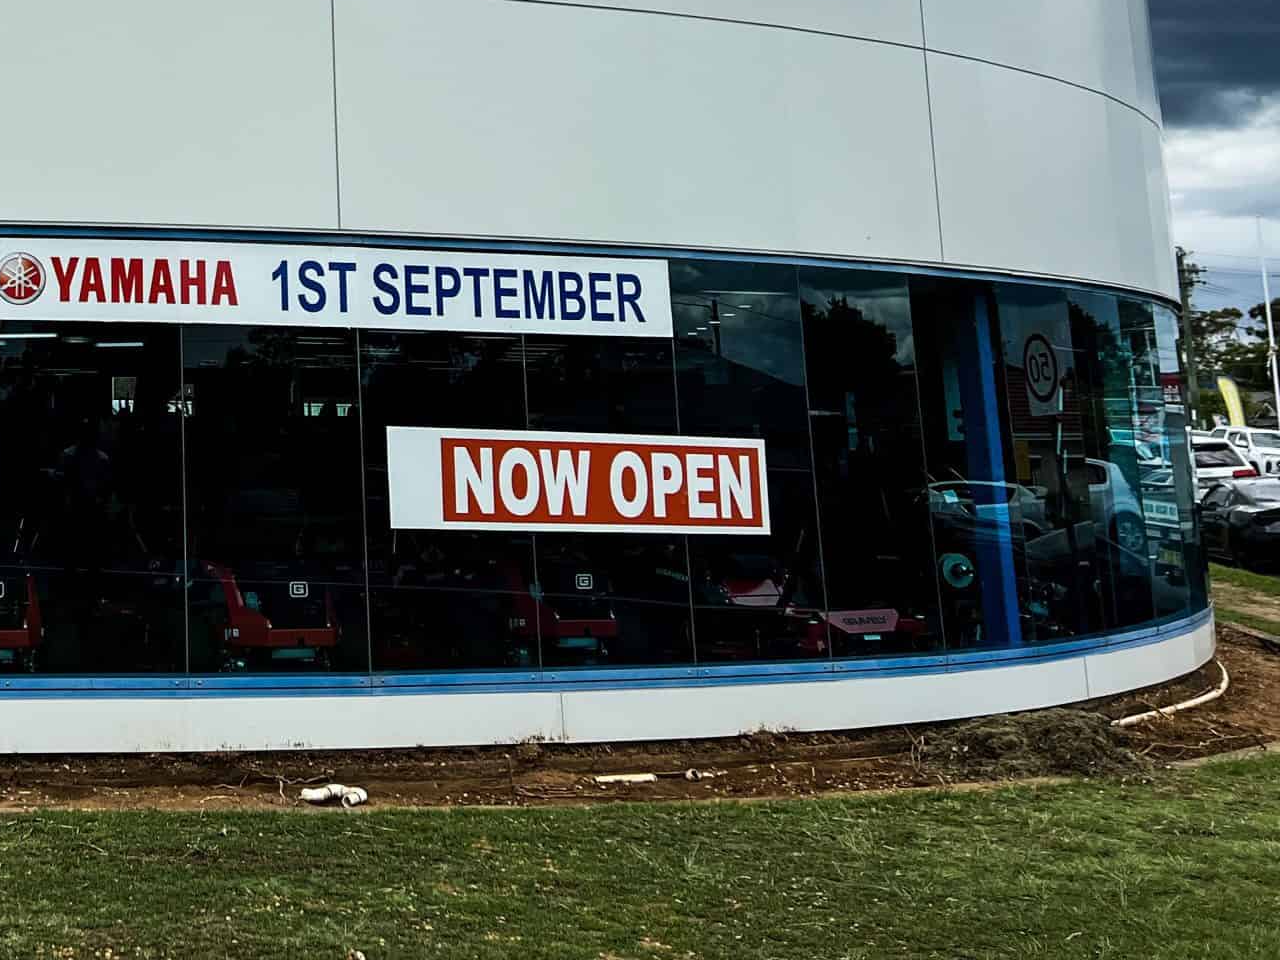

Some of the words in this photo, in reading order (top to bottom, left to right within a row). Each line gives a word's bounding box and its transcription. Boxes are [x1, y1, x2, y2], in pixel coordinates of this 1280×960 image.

[51, 256, 239, 306] YAMAHA
[271, 260, 357, 313] 1ST
[371, 263, 646, 323] SEPTEMBER
[453, 446, 591, 518] NOW
[609, 451, 754, 520] OPEN
